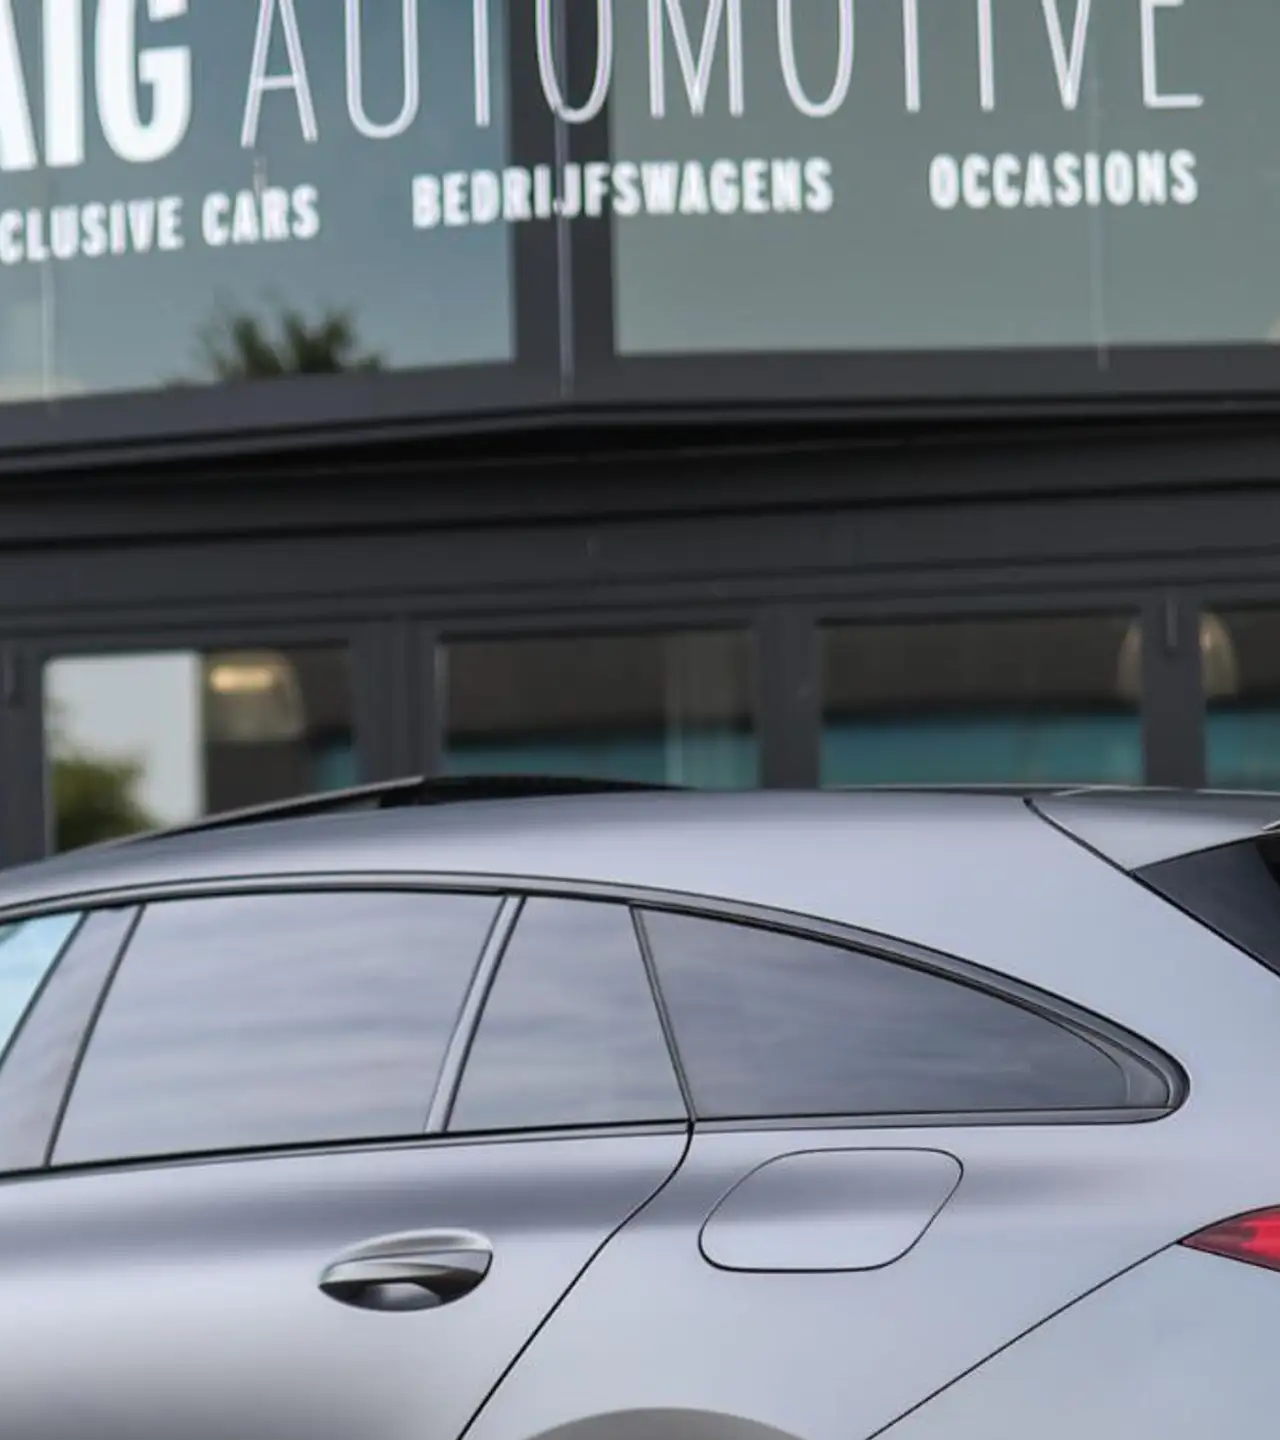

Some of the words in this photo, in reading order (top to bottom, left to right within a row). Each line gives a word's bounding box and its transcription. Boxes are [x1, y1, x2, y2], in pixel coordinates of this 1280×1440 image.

[411, 158, 834, 230] BEDRIJFSWAGENS
[928, 150, 1199, 210] OCCASIONS
[202, 186, 320, 246] CARS
